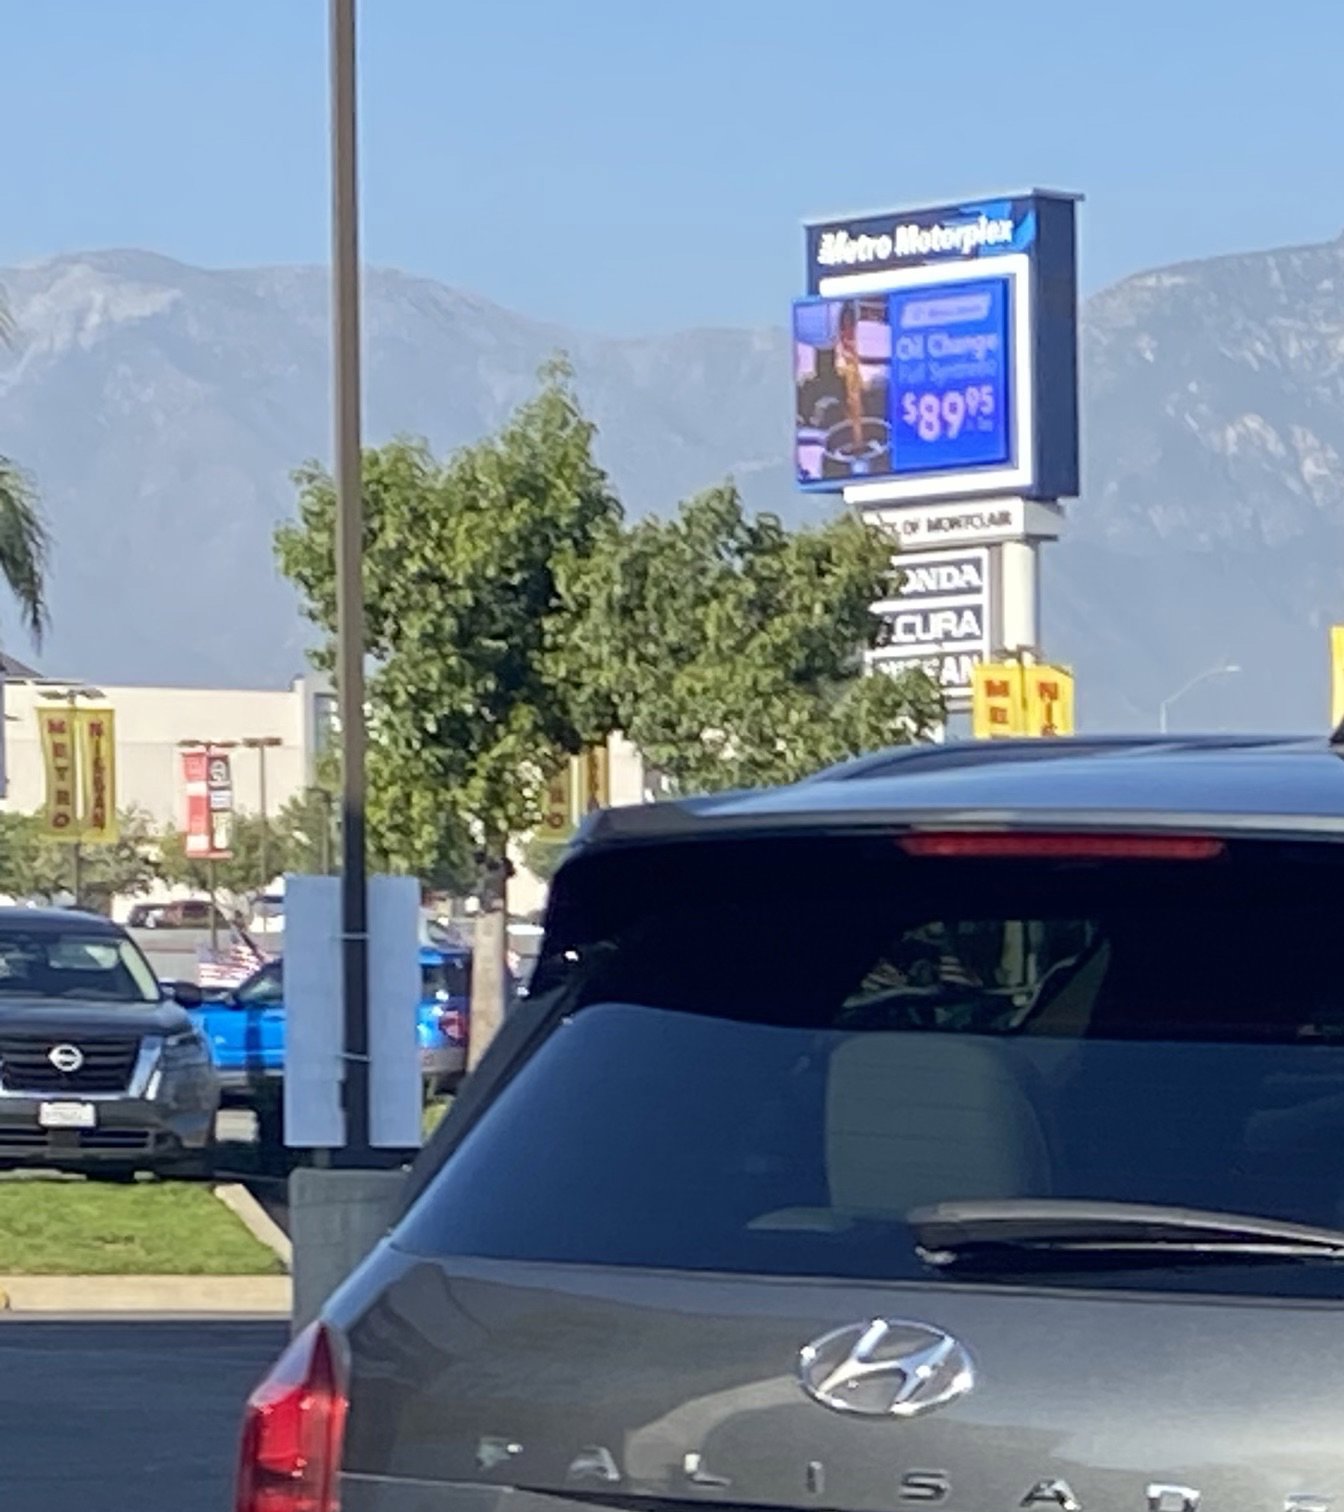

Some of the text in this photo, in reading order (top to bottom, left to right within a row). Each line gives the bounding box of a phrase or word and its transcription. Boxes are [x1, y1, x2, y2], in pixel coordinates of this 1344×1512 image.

[817, 214, 1014, 265] Metro Motorplex
[892, 609, 981, 643] CURA
[47, 719, 71, 828] METRO
